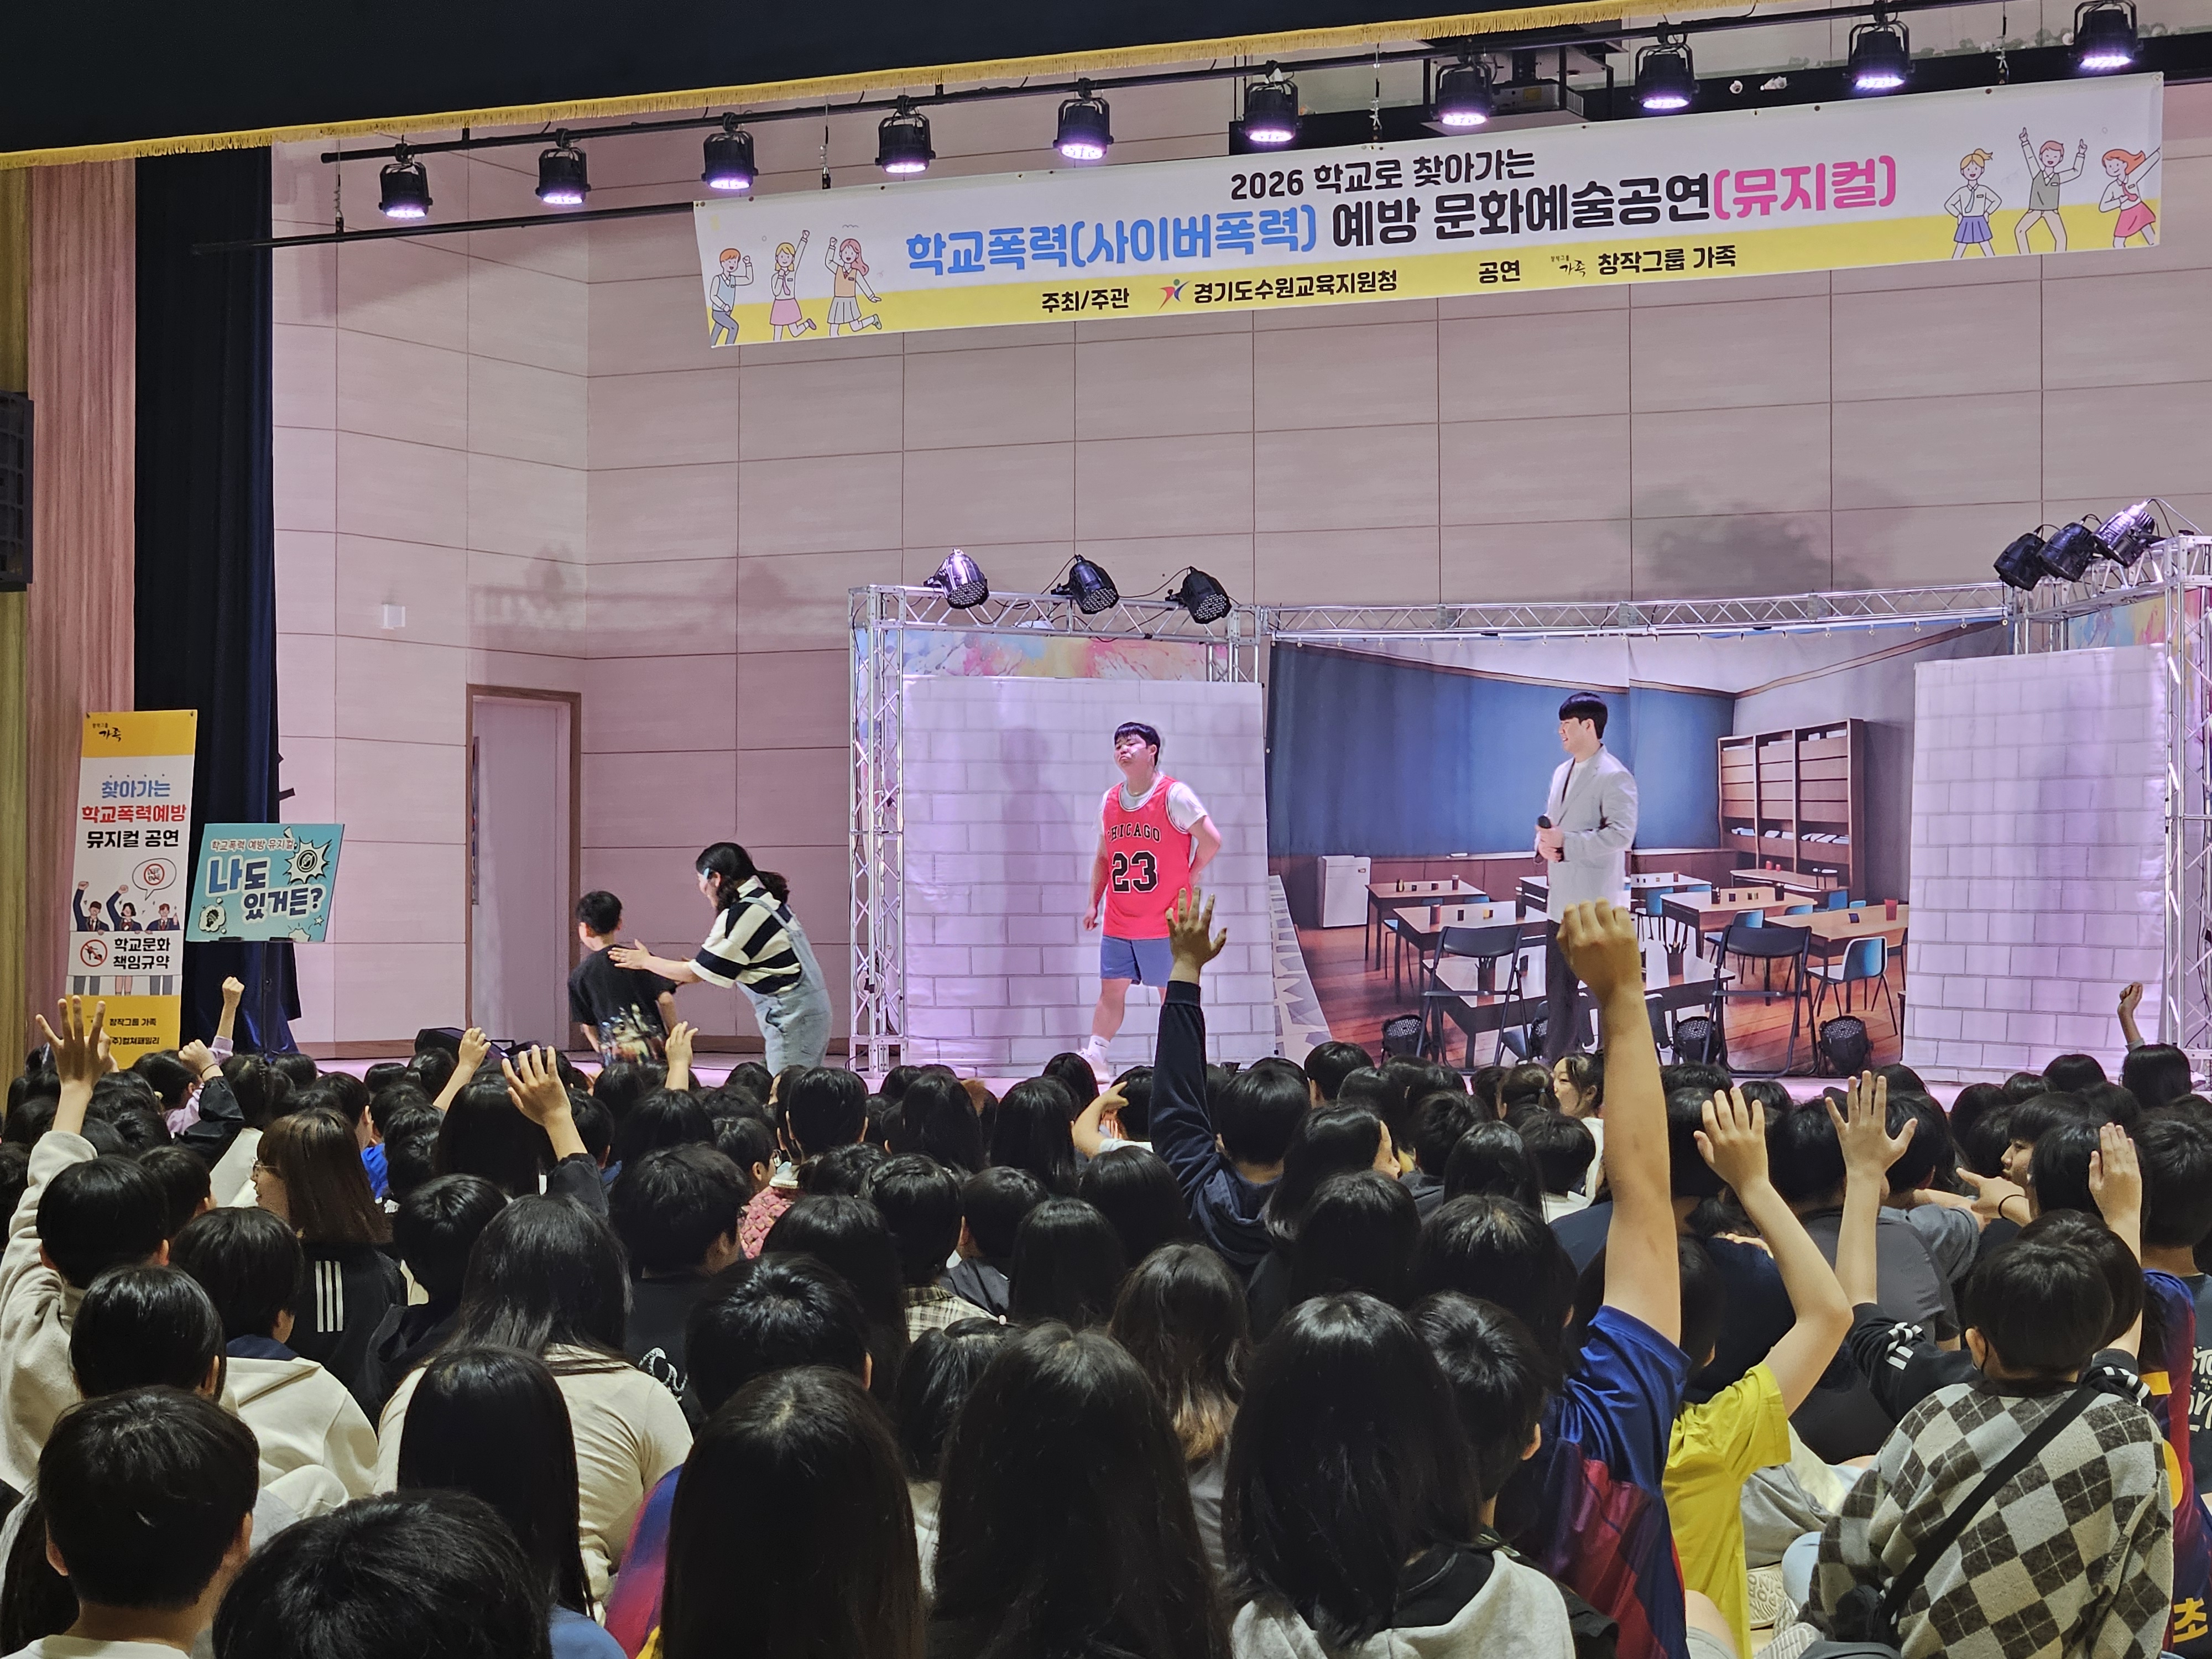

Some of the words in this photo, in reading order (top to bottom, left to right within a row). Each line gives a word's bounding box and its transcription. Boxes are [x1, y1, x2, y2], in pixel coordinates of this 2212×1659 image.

[1231, 169, 1304, 200] 2026
[1313, 159, 1403, 194] 학교로
[1413, 148, 1535, 187] 찾아가는
[906, 204, 1316, 276] 학교폭력(사이버폭력)
[1332, 197, 1421, 247] 예방
[1434, 155, 1896, 240] 문화예술공연(뮤지컬)
[1479, 259, 1521, 284] 공연
[1598, 248, 1685, 275] 창작그룹
[1693, 244, 1736, 269] 가족
[1042, 288, 1130, 313] 주최/주관
[1193, 269, 1397, 304] 경기도수원교육지원청
[102, 780, 170, 799] 찾아가는
[82, 804, 186, 823] 학교폭력예방
[86, 830, 139, 849] 뮤지컬
[145, 830, 179, 848] 공연
[248, 839, 267, 850] 예방
[208, 858, 268, 894] 나도
[1112, 851, 1159, 893] 23
[243, 887, 323, 921] 있거든?
[114, 937, 171, 952] 학교문화
[113, 955, 170, 970] 책임규약
